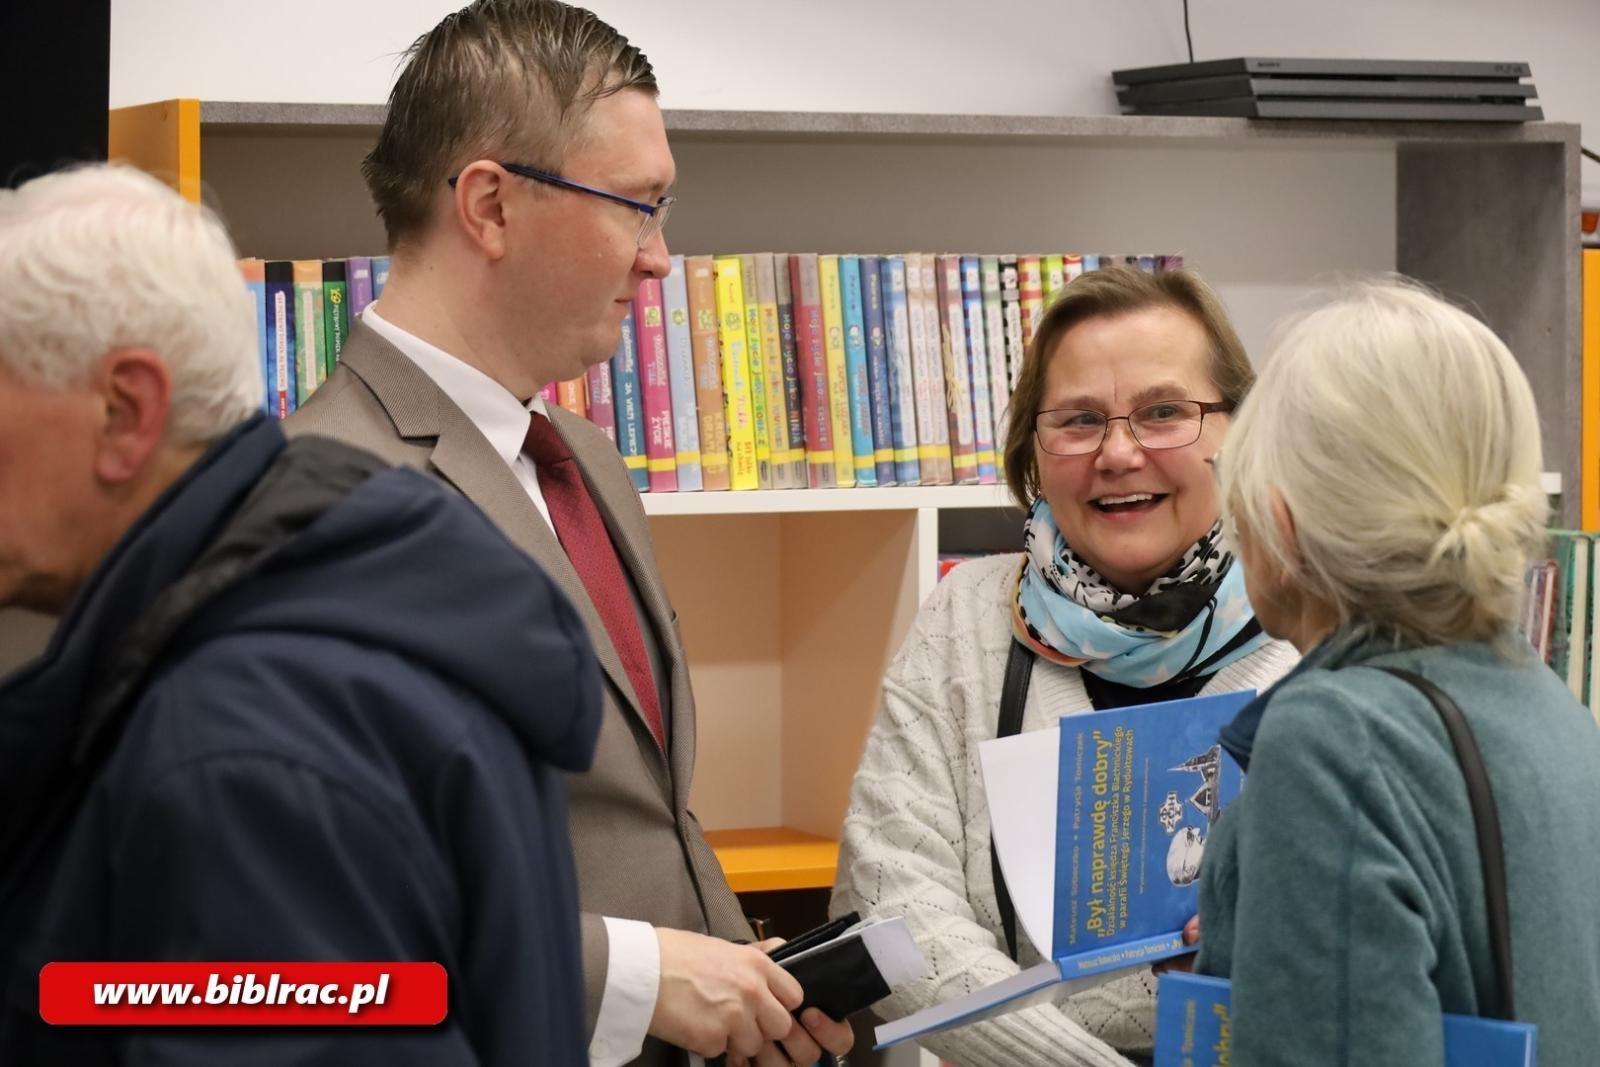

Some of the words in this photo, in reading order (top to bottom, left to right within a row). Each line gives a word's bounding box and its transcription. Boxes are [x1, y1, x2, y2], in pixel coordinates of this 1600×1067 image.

[789, 410, 801, 444] NINJA
[1109, 792, 1120, 843] Franciszka
[1089, 799, 1111, 894] naprawdę
[1117, 842, 1130, 886] Świętego
